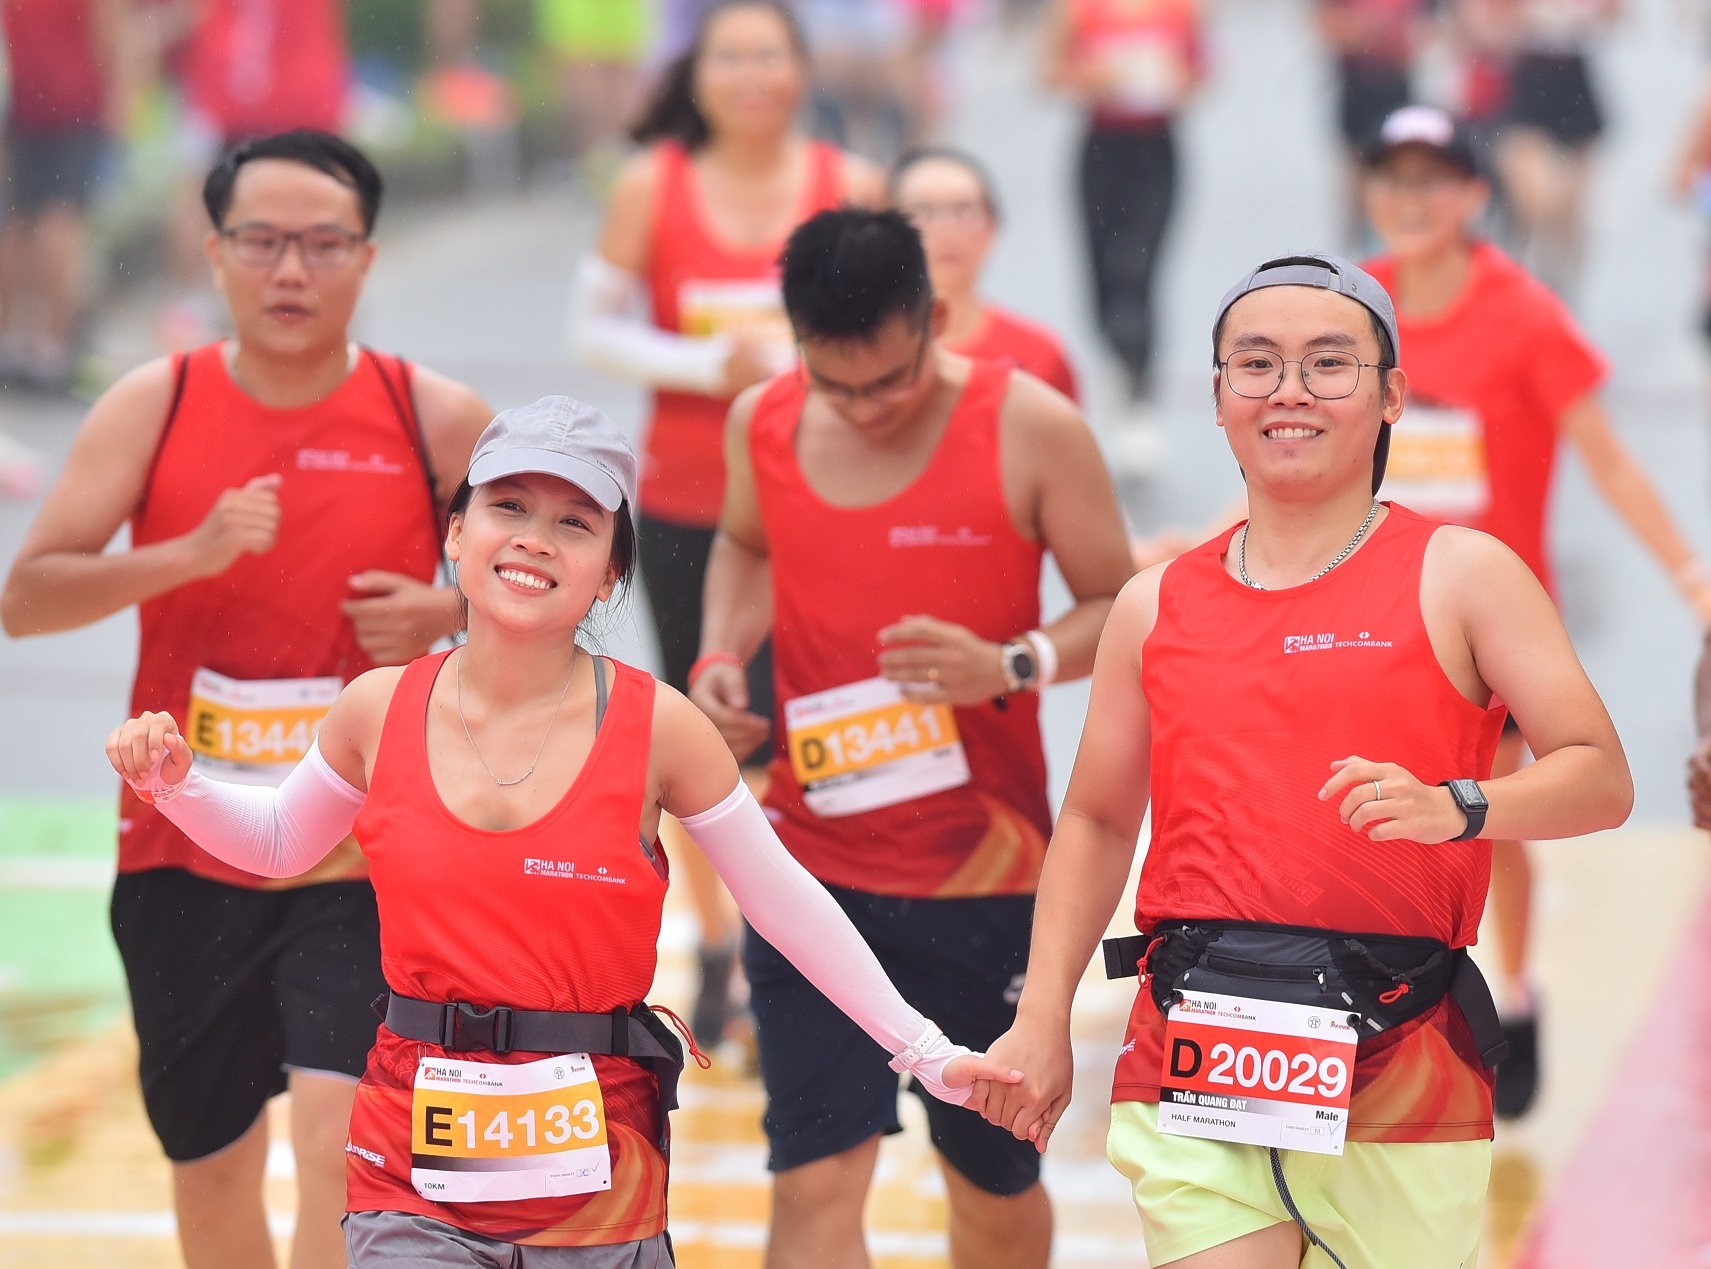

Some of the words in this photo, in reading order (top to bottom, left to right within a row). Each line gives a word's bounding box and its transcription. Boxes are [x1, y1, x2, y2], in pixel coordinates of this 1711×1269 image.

[1300, 634, 1314, 645] HA
[1317, 633, 1335, 644] NOI
[1300, 643, 1333, 651] MARATHON
[1335, 640, 1393, 648] TECHCOMBANK
[541, 859, 554, 871] HA
[557, 861, 575, 872] NOI
[540, 870, 574, 878] MARATHON
[576, 873, 626, 884] TECHCOMBANK
[1191, 999, 1201, 1008] HA
[1204, 1001, 1217, 1010] NOI
[1218, 1011, 1257, 1020] TECHCOMBANK
[436, 1067, 447, 1076] HA
[449, 1068, 462, 1077] NOI
[463, 1079, 504, 1087] TECHCOMBANK
[1198, 1095, 1228, 1109] QUANG
[1229, 1098, 1248, 1111] ĐẠT
[1171, 1113, 1192, 1122] HALF
[1193, 1116, 1236, 1128] MARATHON
[1315, 1110, 1338, 1122] Male
[425, 1099, 600, 1149] E14133
[424, 1182, 446, 1191] 10KM
